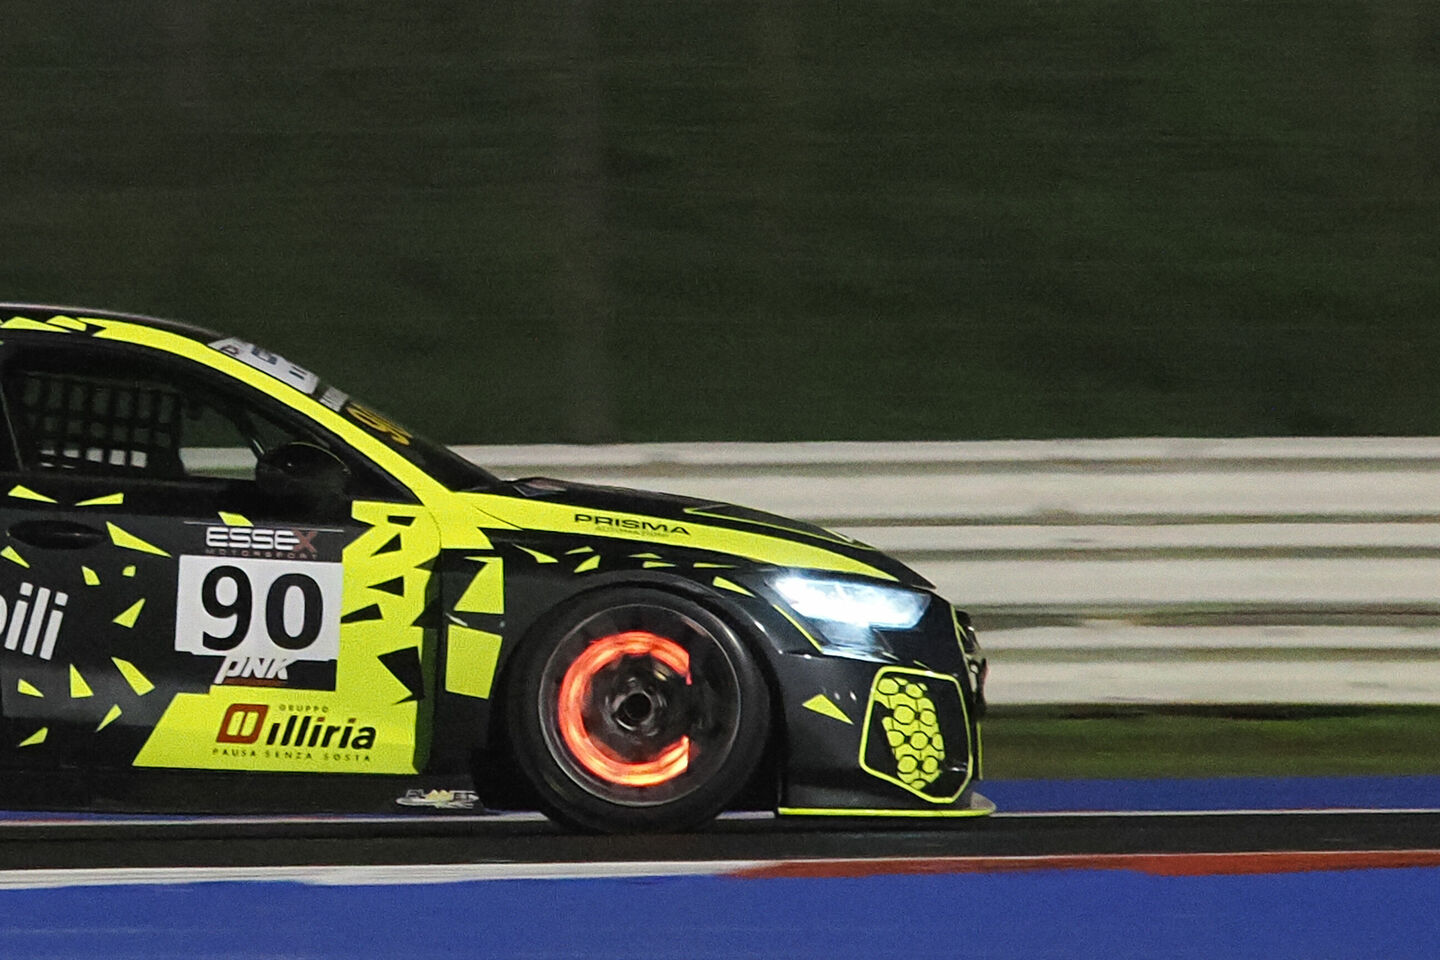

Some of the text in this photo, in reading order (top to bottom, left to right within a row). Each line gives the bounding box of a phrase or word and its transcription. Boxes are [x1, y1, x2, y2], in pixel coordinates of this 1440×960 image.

[574, 513, 691, 536] PRISMA
[206, 526, 317, 553] ESSEX
[205, 548, 317, 559] MOTORSPORT
[201, 565, 323, 651] 90
[278, 703, 329, 714] GRUPPO
[212, 747, 371, 763] PAUSA SENZA SOSTA
